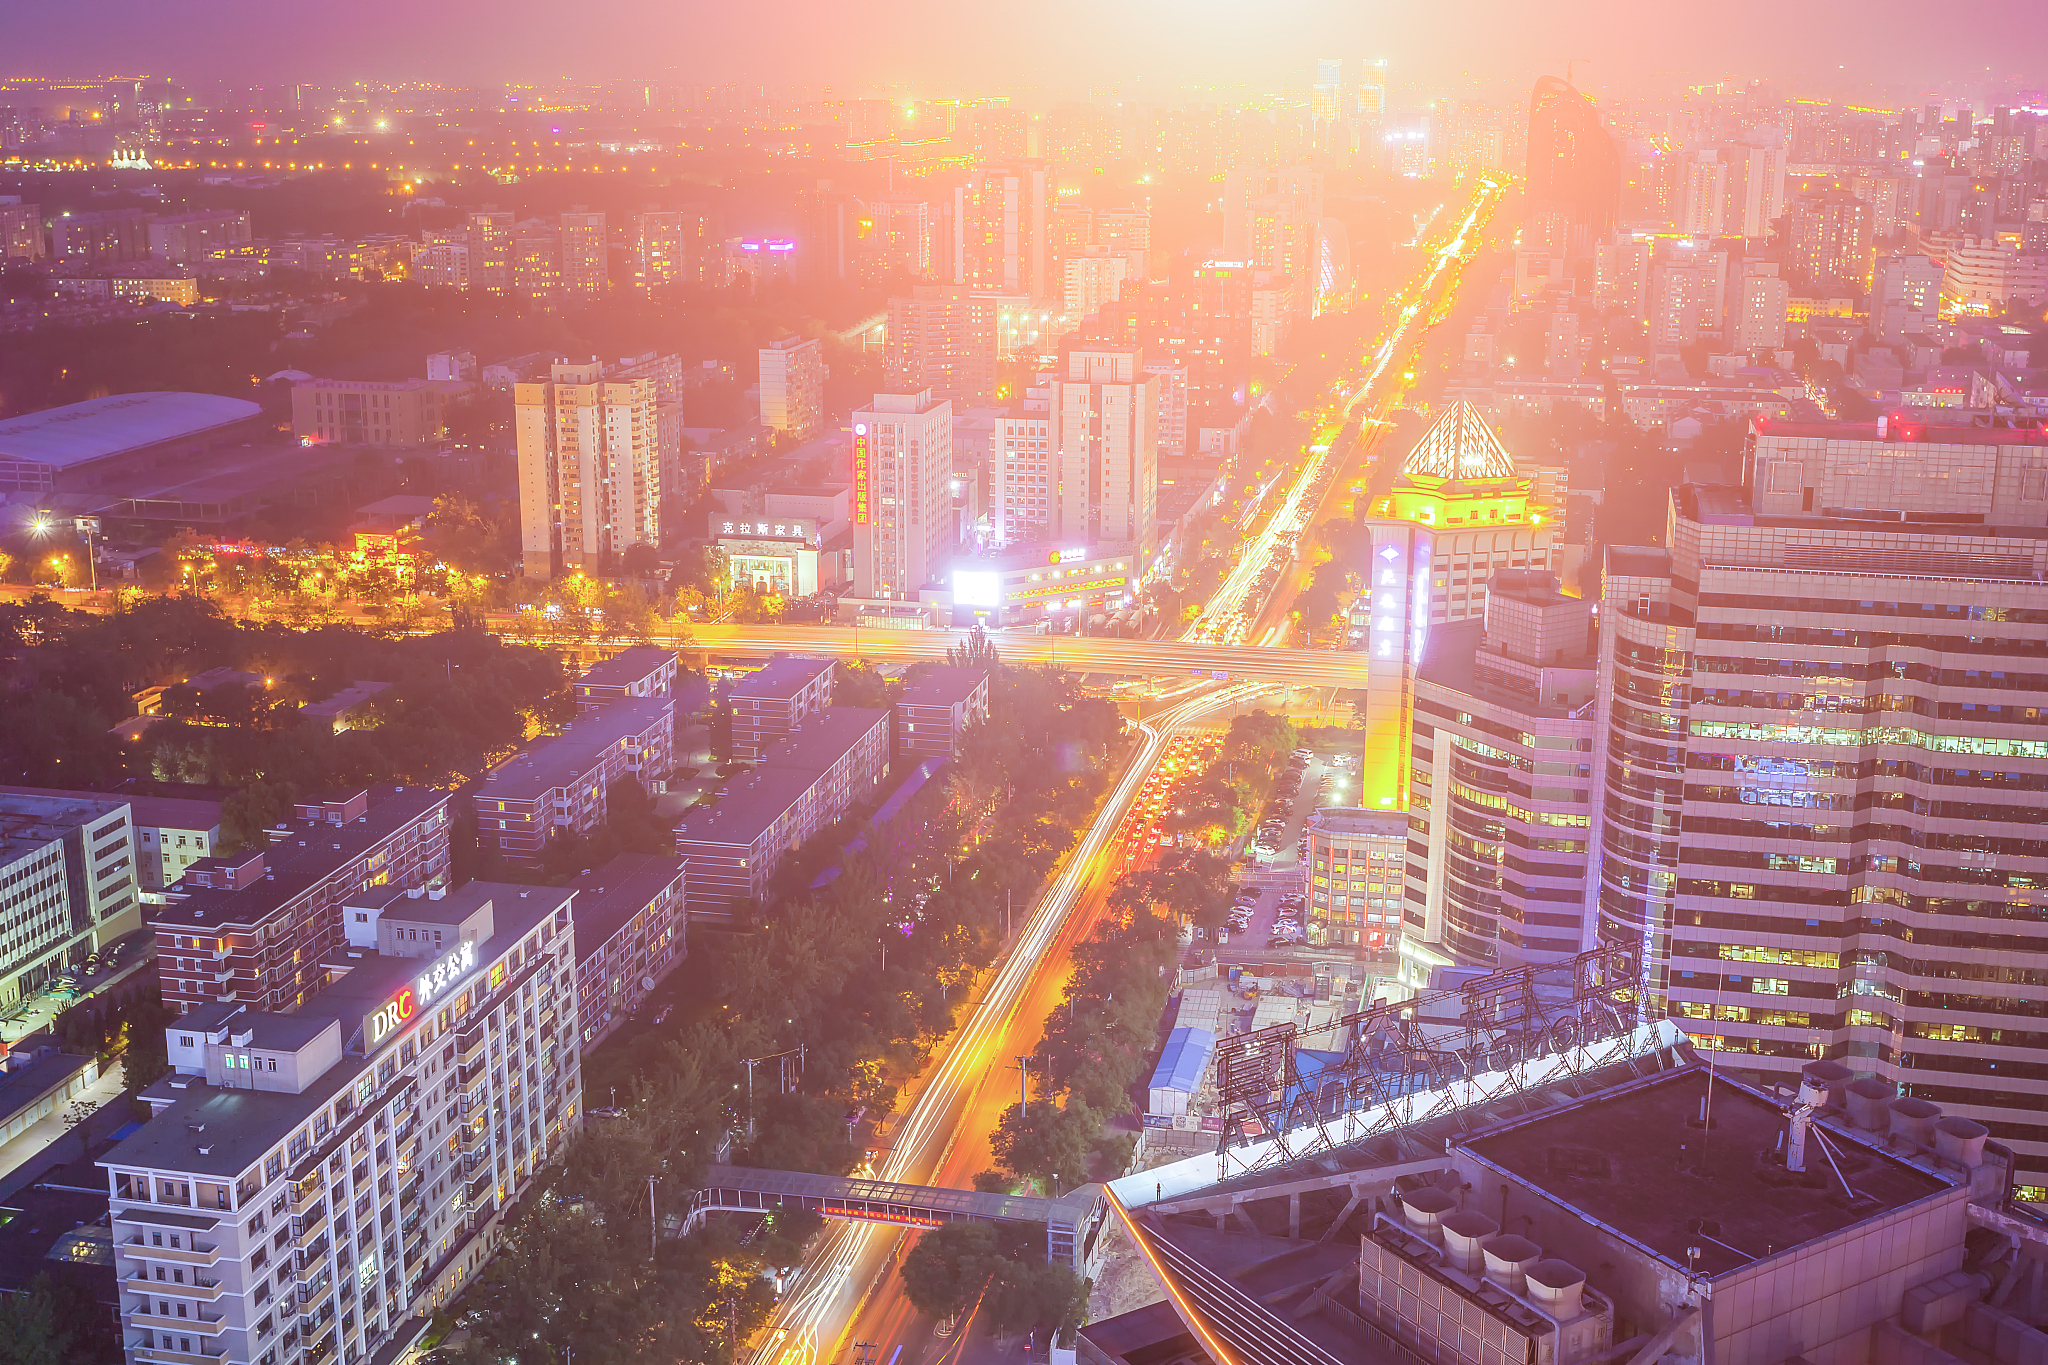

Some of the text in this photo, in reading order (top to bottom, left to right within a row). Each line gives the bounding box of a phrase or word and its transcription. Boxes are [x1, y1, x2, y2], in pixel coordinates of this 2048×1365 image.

[856, 437, 867, 523] 中国作家出版集团
[723, 521, 804, 537] 克拉斯家具
[740, 859, 746, 867] 6
[372, 940, 474, 1043] DRC 外交公寓
